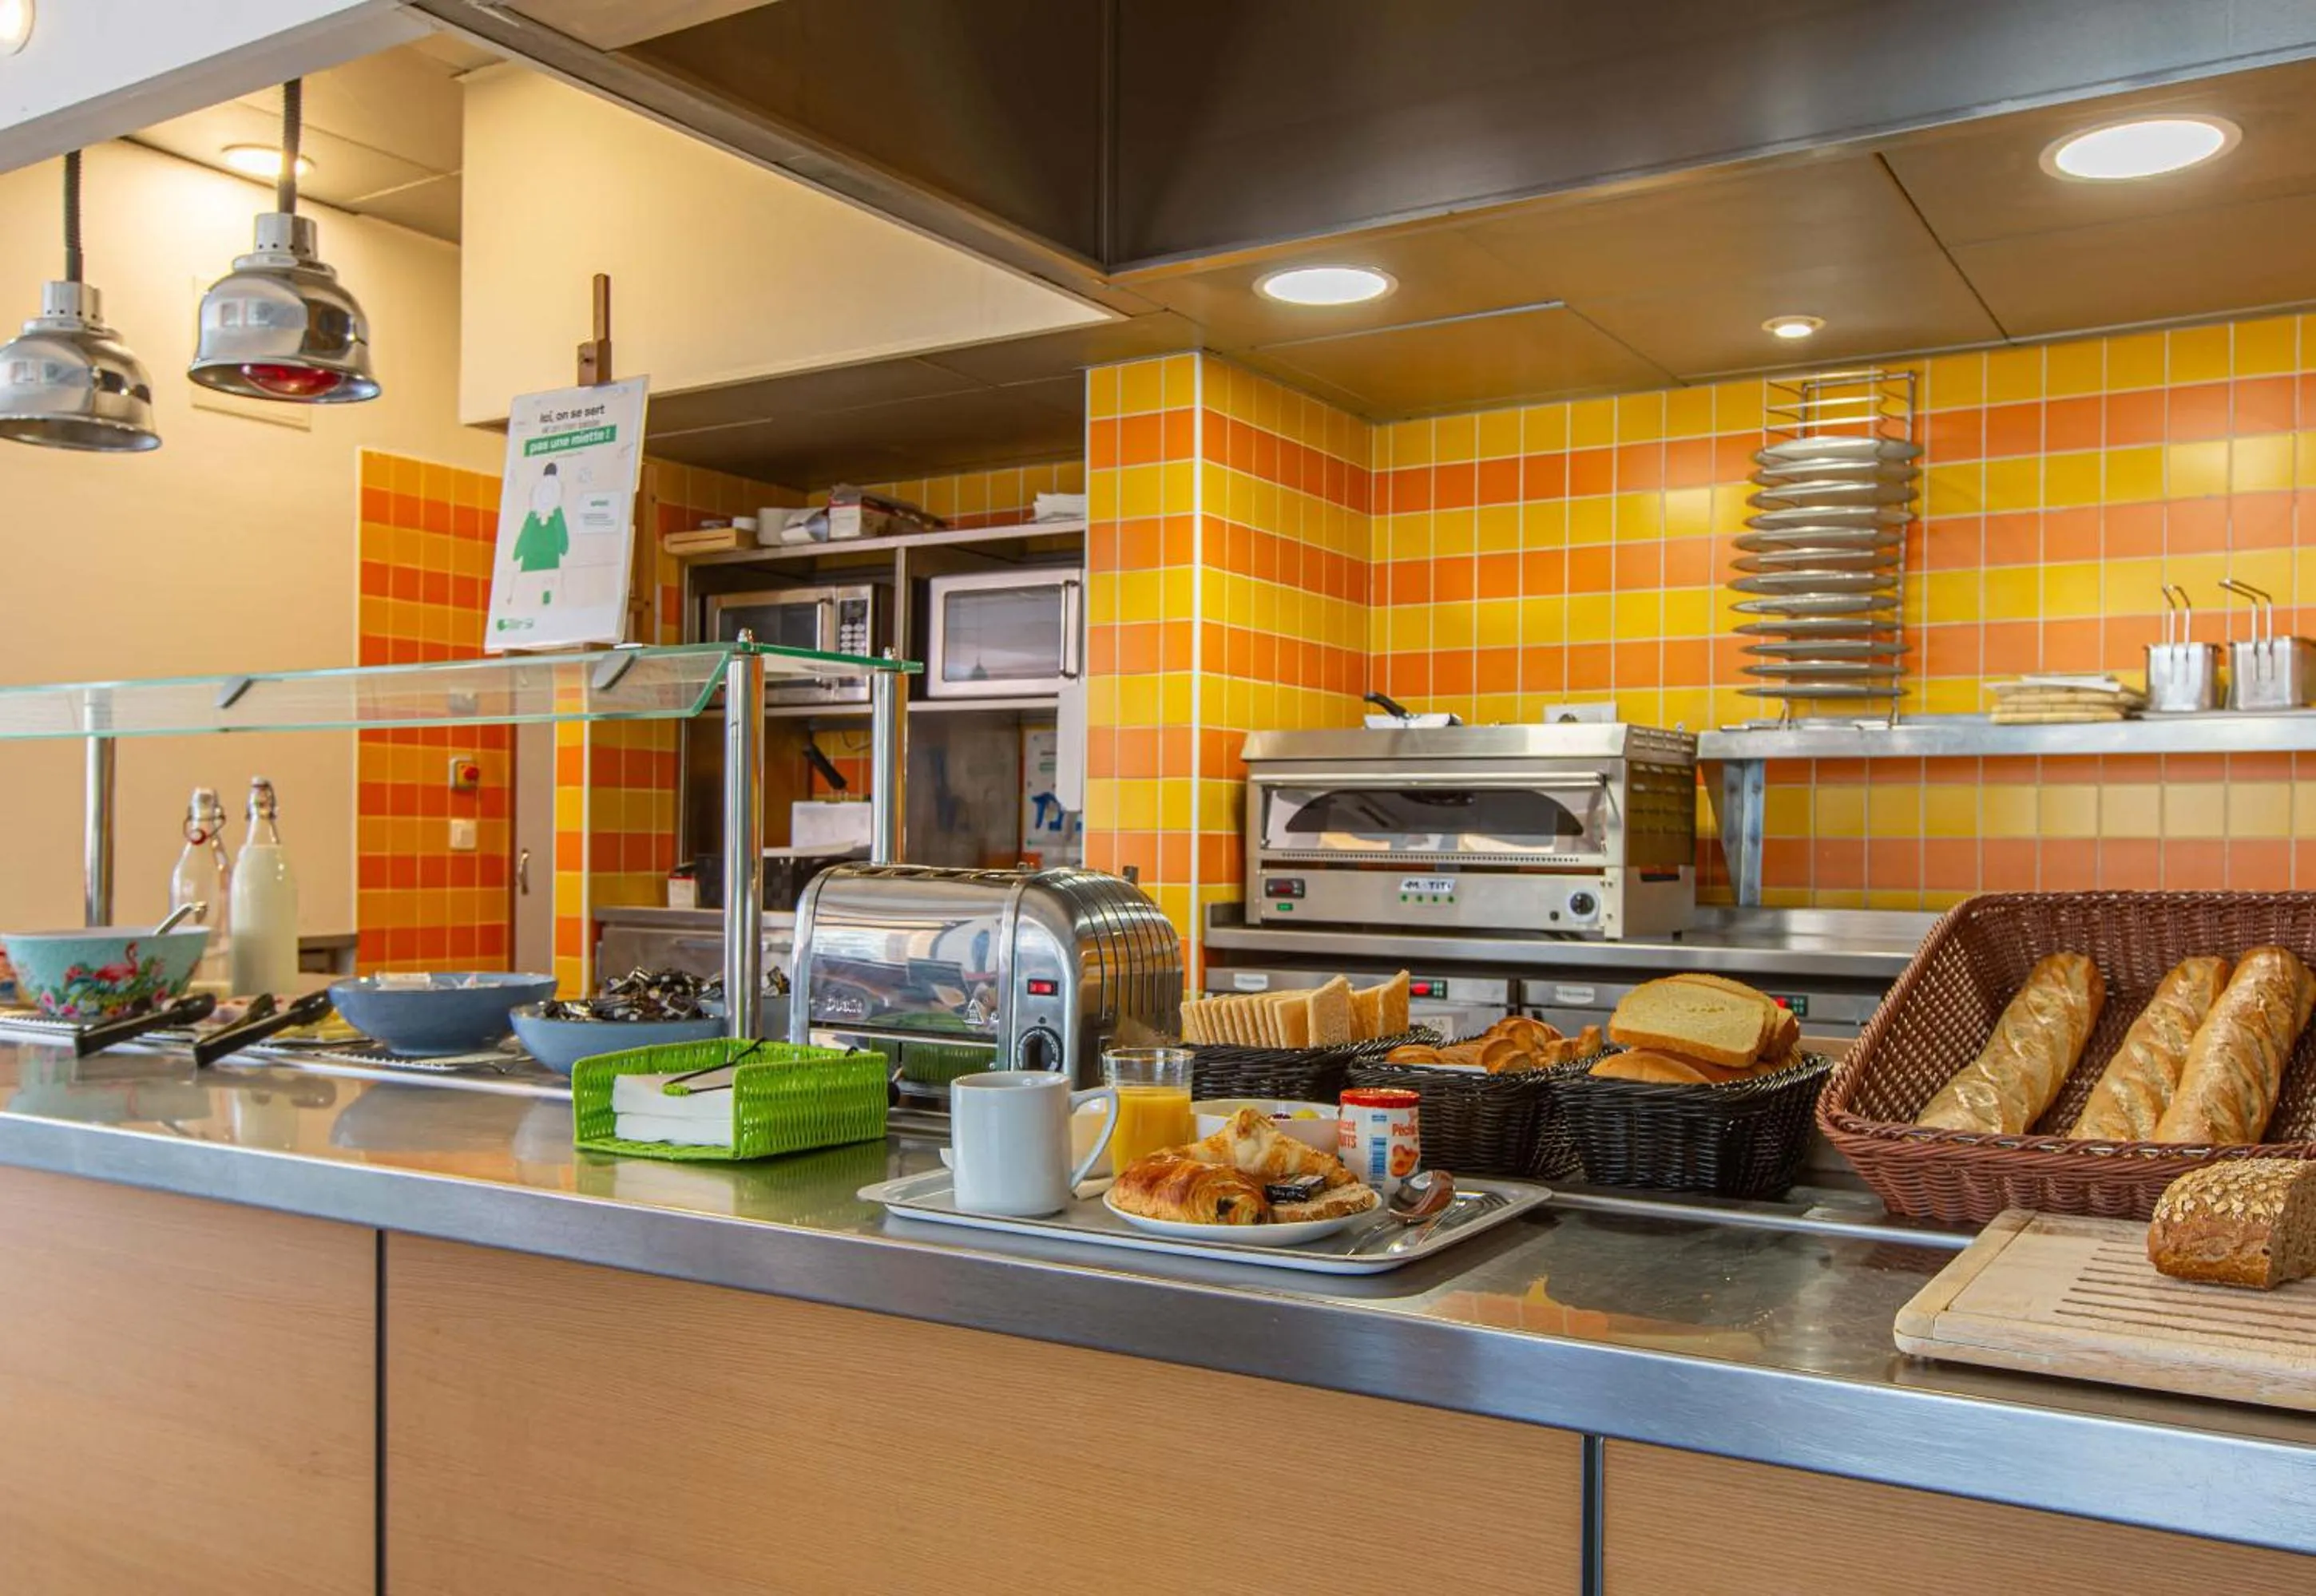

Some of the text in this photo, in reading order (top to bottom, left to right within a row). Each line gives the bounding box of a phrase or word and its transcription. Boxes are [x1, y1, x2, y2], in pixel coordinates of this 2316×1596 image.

[556, 411, 569, 421] on
[570, 409, 582, 418] se
[585, 404, 605, 416] sert
